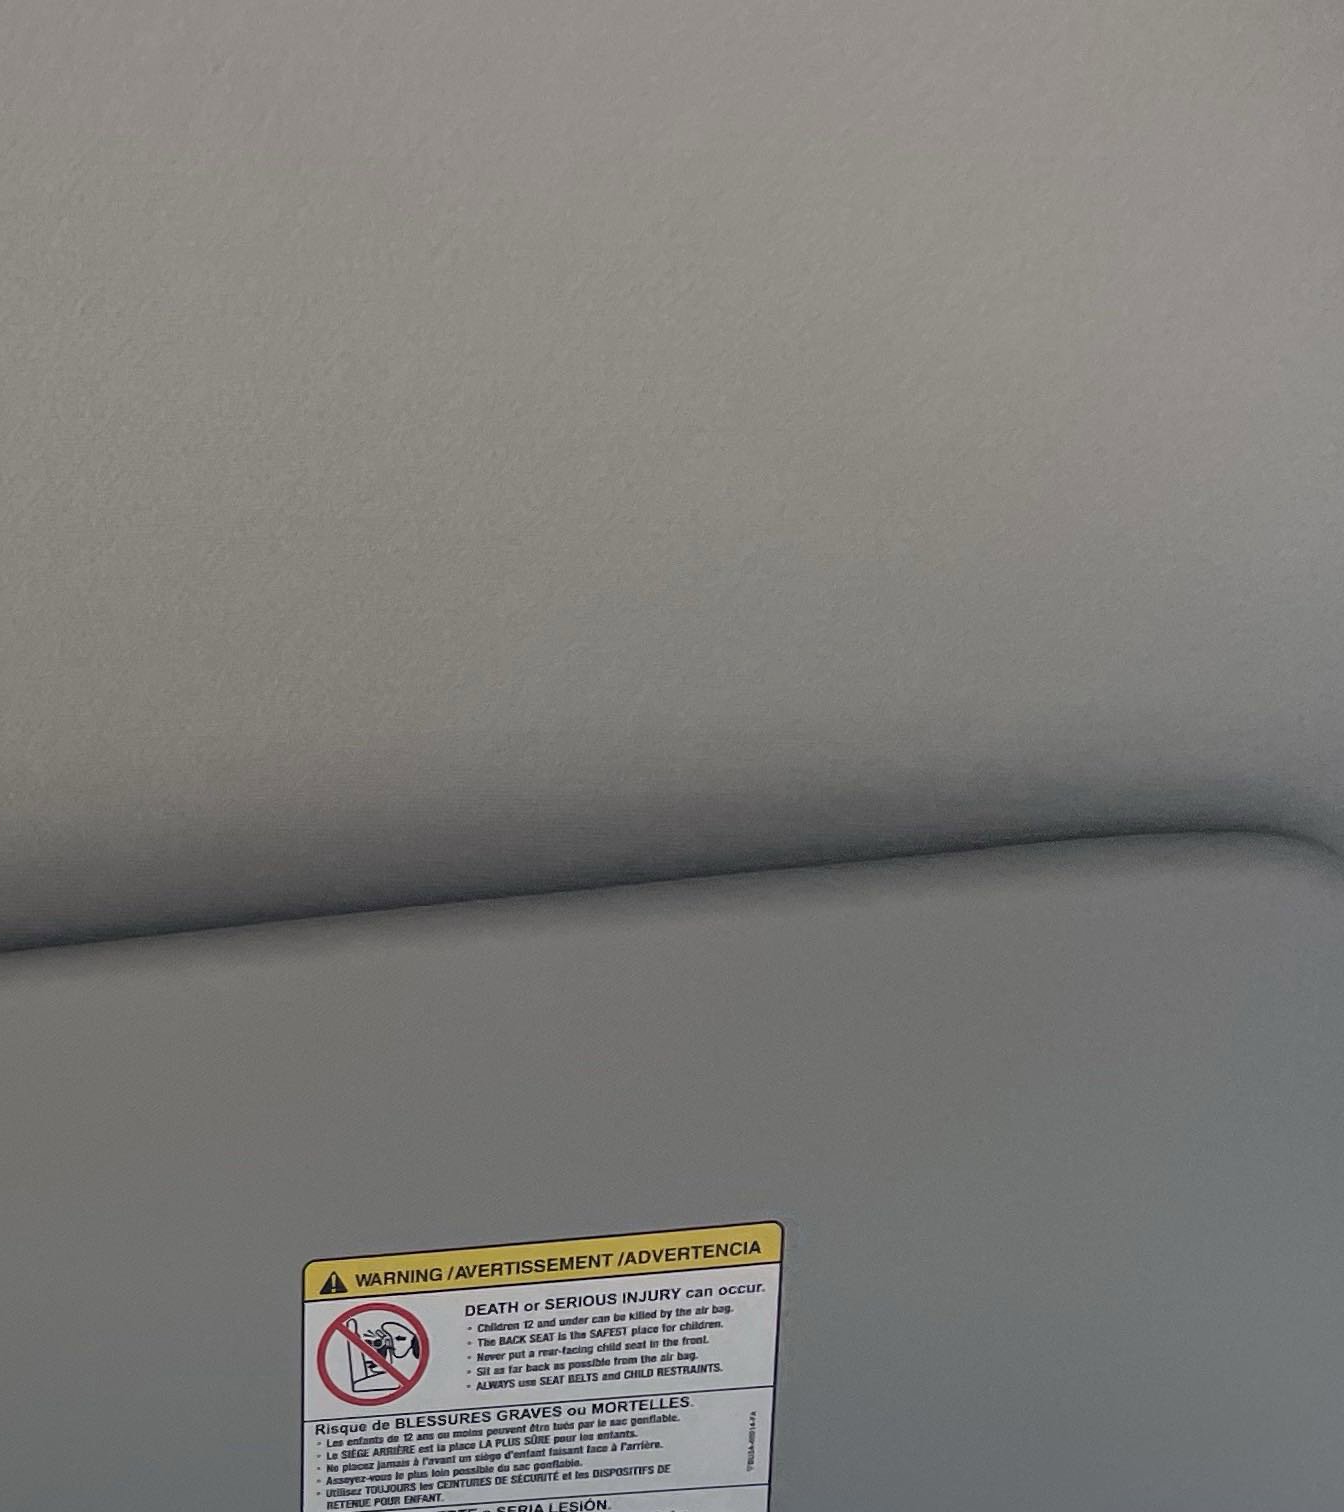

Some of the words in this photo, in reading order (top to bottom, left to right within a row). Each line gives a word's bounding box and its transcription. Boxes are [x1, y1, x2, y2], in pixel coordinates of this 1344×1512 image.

[354, 1266, 443, 1288] WARNING
[464, 1300, 519, 1317] DEATH
[523, 1301, 540, 1312] or
[543, 1292, 617, 1310] SERIOUS
[621, 1287, 682, 1304] INJURY
[685, 1287, 713, 1299] can
[717, 1282, 766, 1296] occur.
[476, 1319, 520, 1333] Children
[522, 1319, 534, 1329] 12
[536, 1317, 556, 1328] and
[558, 1314, 589, 1326] under
[591, 1314, 610, 1324] can
[612, 1311, 626, 1322] be
[628, 1309, 657, 1321] killed
[659, 1308, 673, 1320] by
[674, 1306, 692, 1317] the
[694, 1305, 709, 1315] air
[711, 1302, 734, 1315] bag.
[476, 1336, 496, 1347] The
[498, 1334, 527, 1346] BACK
[528, 1331, 555, 1343] SEAT
[557, 1331, 567, 1341] is
[569, 1329, 587, 1340] the
[589, 1326, 627, 1339] SAFEST
[630, 1323, 659, 1337] place
[661, 1322, 677, 1333] for
[679, 1318, 724, 1331] children.
[475, 1365, 491, 1376] Sit
[492, 1366, 505, 1375] as
[507, 1363, 523, 1374] far
[525, 1361, 550, 1373] back
[552, 1362, 565, 1370] as
[567, 1356, 611, 1371] possible
[613, 1354, 638, 1366] from
[639, 1353, 657, 1364] the
[659, 1351, 674, 1362] air
[676, 1349, 699, 1363] bag.
[476, 1350, 506, 1362] Never
[508, 1349, 526, 1361] put
[527, 1349, 535, 1358] a
[537, 1343, 594, 1359] rear-facing
[596, 1341, 622, 1352] child
[624, 1339, 647, 1350] seat
[649, 1339, 659, 1348] in
[661, 1337, 679, 1347] the
[681, 1334, 710, 1346] front.
[475, 1378, 516, 1391] ALWAYS
[517, 1378, 536, 1387] use
[539, 1374, 565, 1386] SEAT
[567, 1372, 599, 1384] BELTS
[601, 1370, 621, 1381] and
[623, 1367, 654, 1380] CHILD
[656, 1362, 723, 1377] RESTRAINTS.
[314, 1420, 368, 1438] Risque
[371, 1418, 390, 1431] de
[393, 1410, 492, 1429] BLESSURES
[495, 1405, 563, 1422] GRAVES
[566, 1406, 587, 1416] ou
[591, 1394, 696, 1415] MORTELLES.
